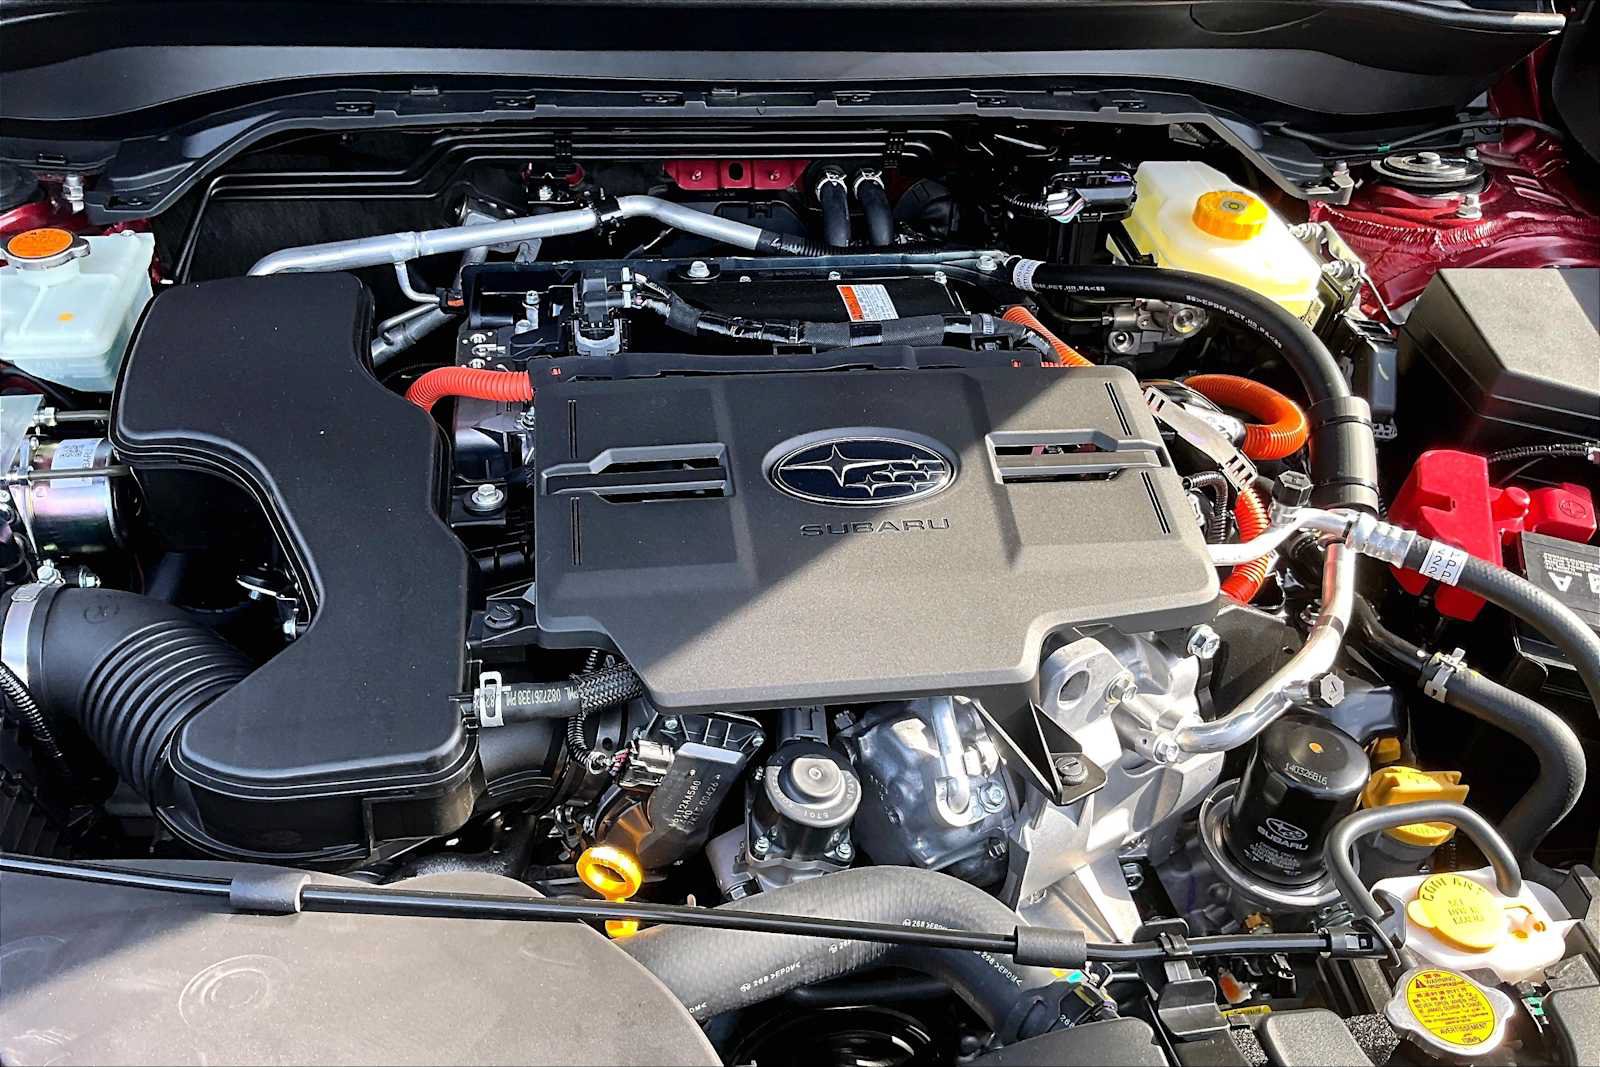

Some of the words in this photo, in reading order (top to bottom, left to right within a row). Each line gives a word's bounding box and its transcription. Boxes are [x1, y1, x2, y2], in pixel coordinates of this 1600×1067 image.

[799, 517, 951, 537] SUBARU
[1432, 555, 1442, 566] 2
[1445, 559, 1457, 569] P
[1257, 825, 1309, 850] SUBARU
